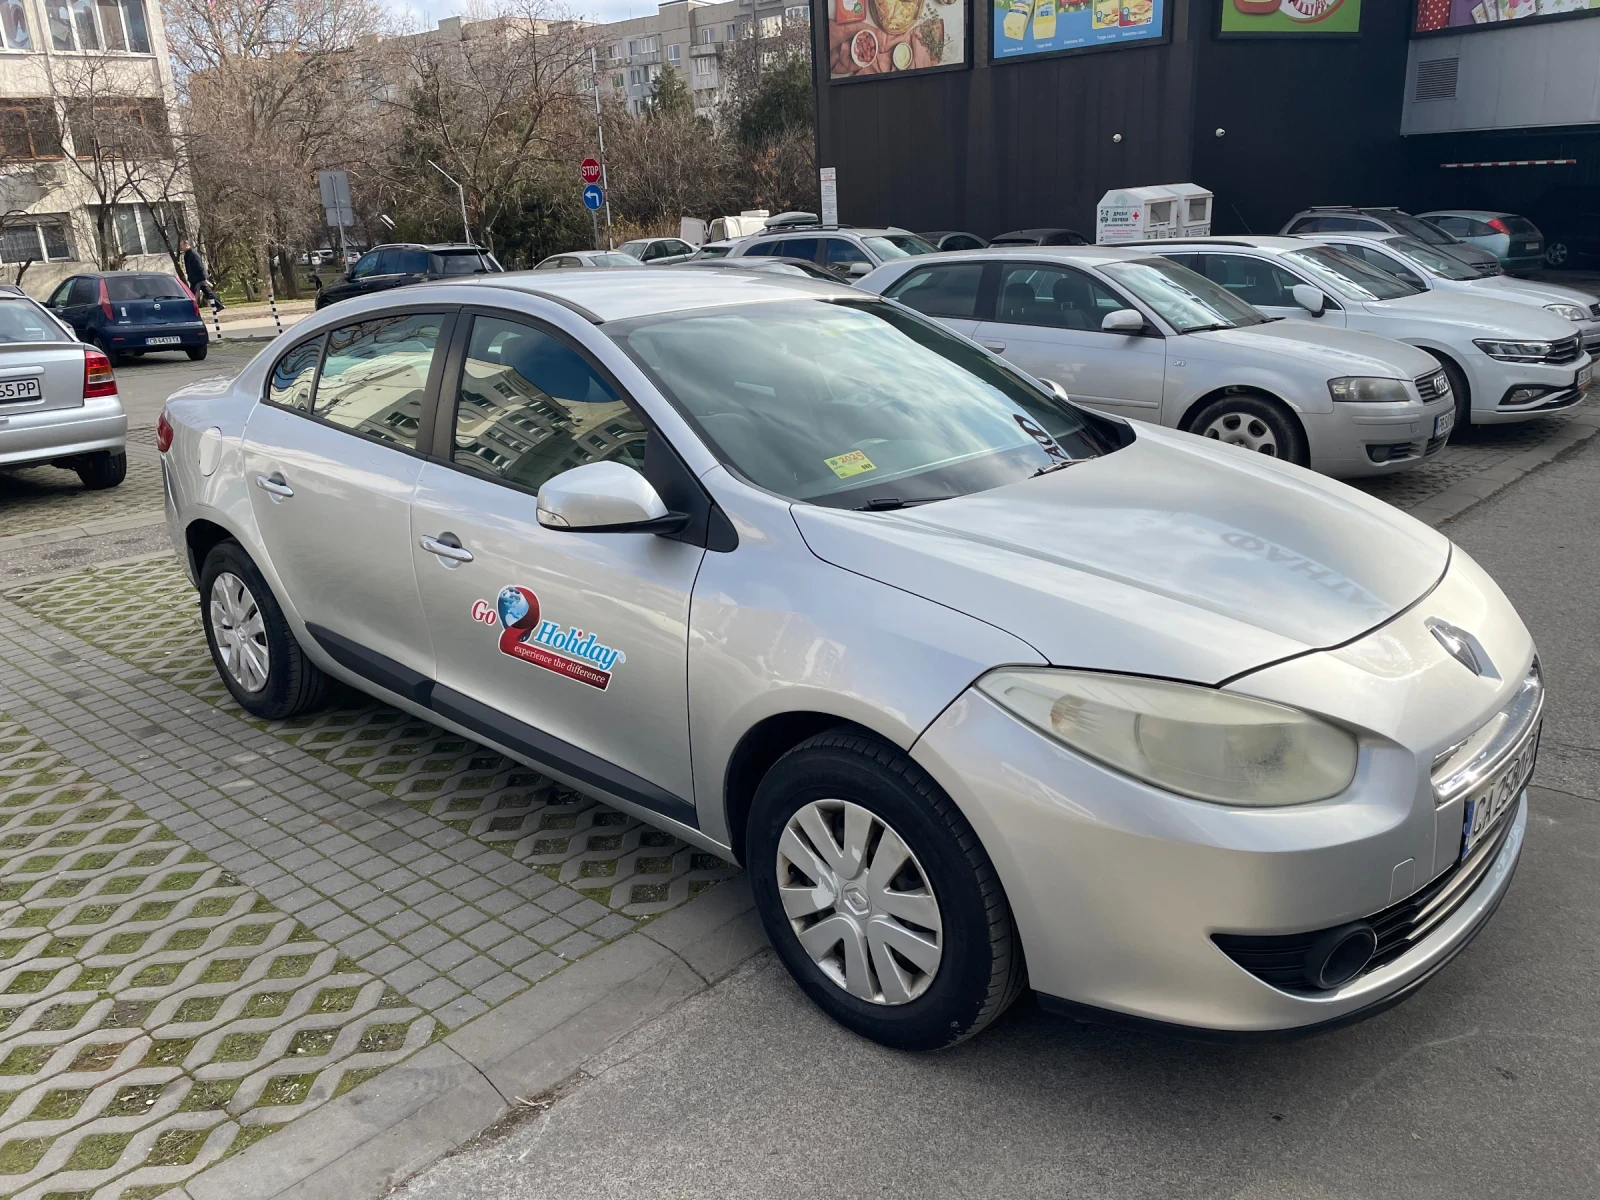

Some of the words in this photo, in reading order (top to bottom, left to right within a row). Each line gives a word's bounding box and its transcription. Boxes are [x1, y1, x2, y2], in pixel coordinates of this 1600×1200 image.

[582, 166, 599, 176] STOP
[17, 381, 36, 396] PP
[838, 452, 865, 464] 2025
[472, 600, 497, 625] Go
[514, 645, 553, 664] experience
[553, 658, 566, 669] the
[566, 664, 606, 684] difference
